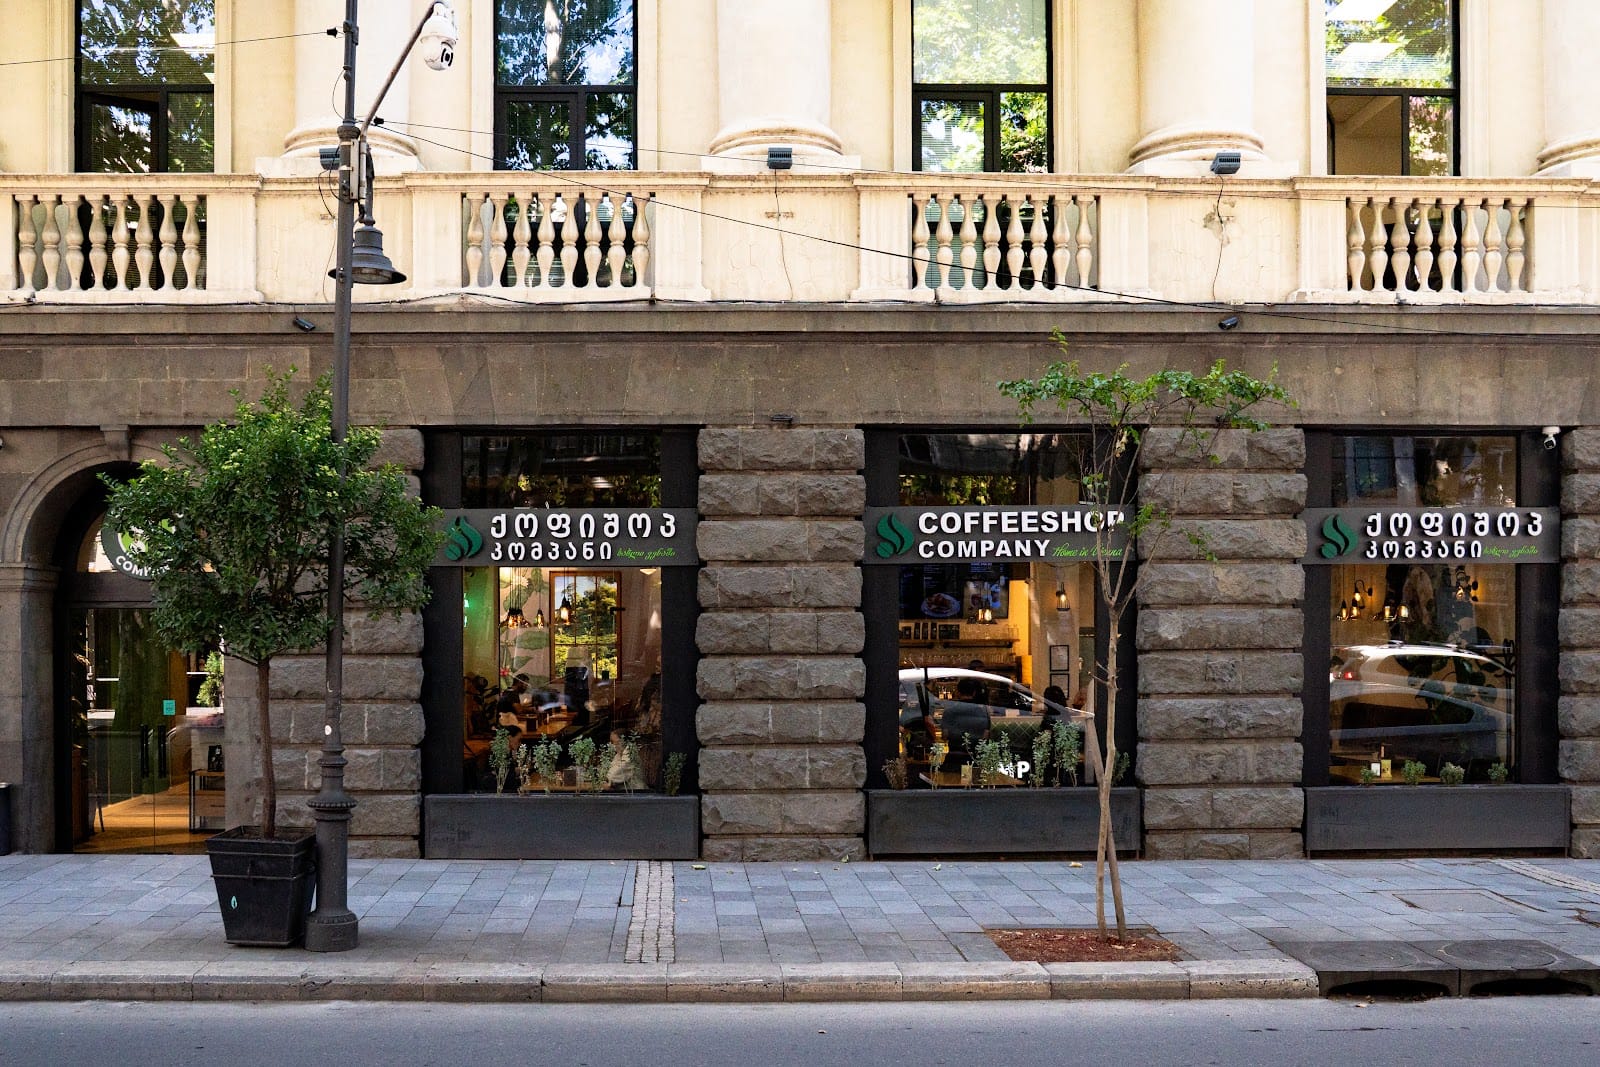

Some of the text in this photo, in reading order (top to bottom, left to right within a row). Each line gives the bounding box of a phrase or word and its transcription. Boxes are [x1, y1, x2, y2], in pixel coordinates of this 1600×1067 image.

[491, 512, 676, 538] ქოფიშოპ
[918, 510, 1125, 534] COFFEESHOP
[1366, 511, 1543, 537] ქოფიშოპ
[490, 541, 612, 561] კომპანი
[918, 539, 1051, 559] COMPANY
[1052, 542, 1078, 557] Home
[1079, 546, 1089, 557] in
[1366, 540, 1482, 559] კომპანი
